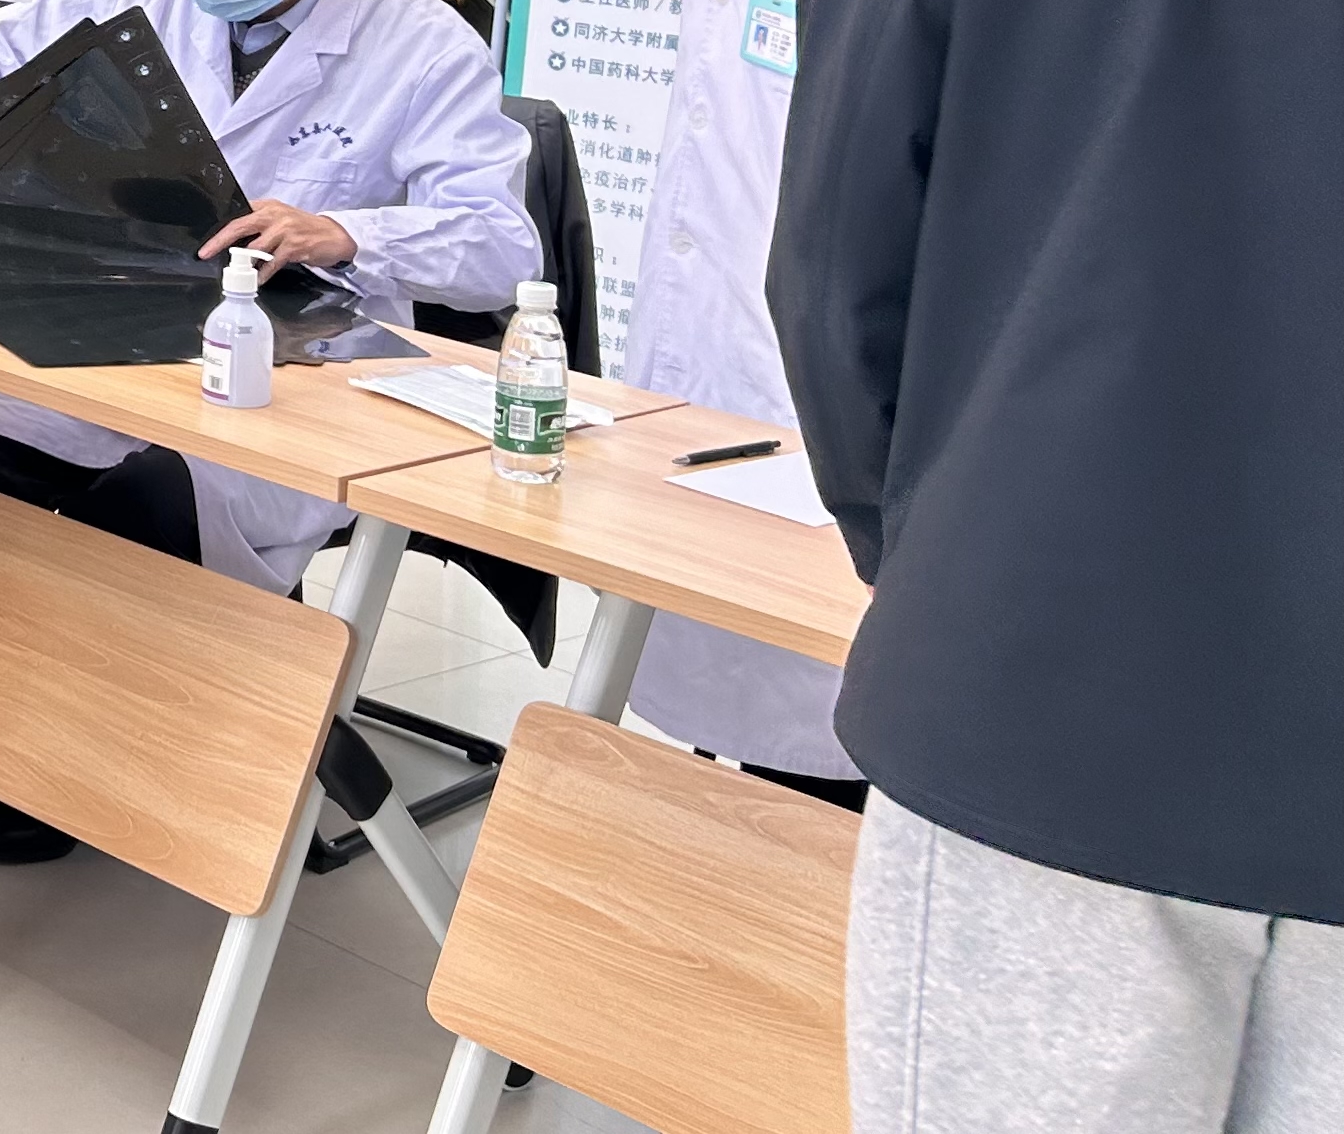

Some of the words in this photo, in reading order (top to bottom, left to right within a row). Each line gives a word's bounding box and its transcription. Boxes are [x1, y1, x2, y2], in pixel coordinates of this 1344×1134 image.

[574, 22, 680, 51] 同济大学附属
[571, 56, 675, 87] 中国药科大学
